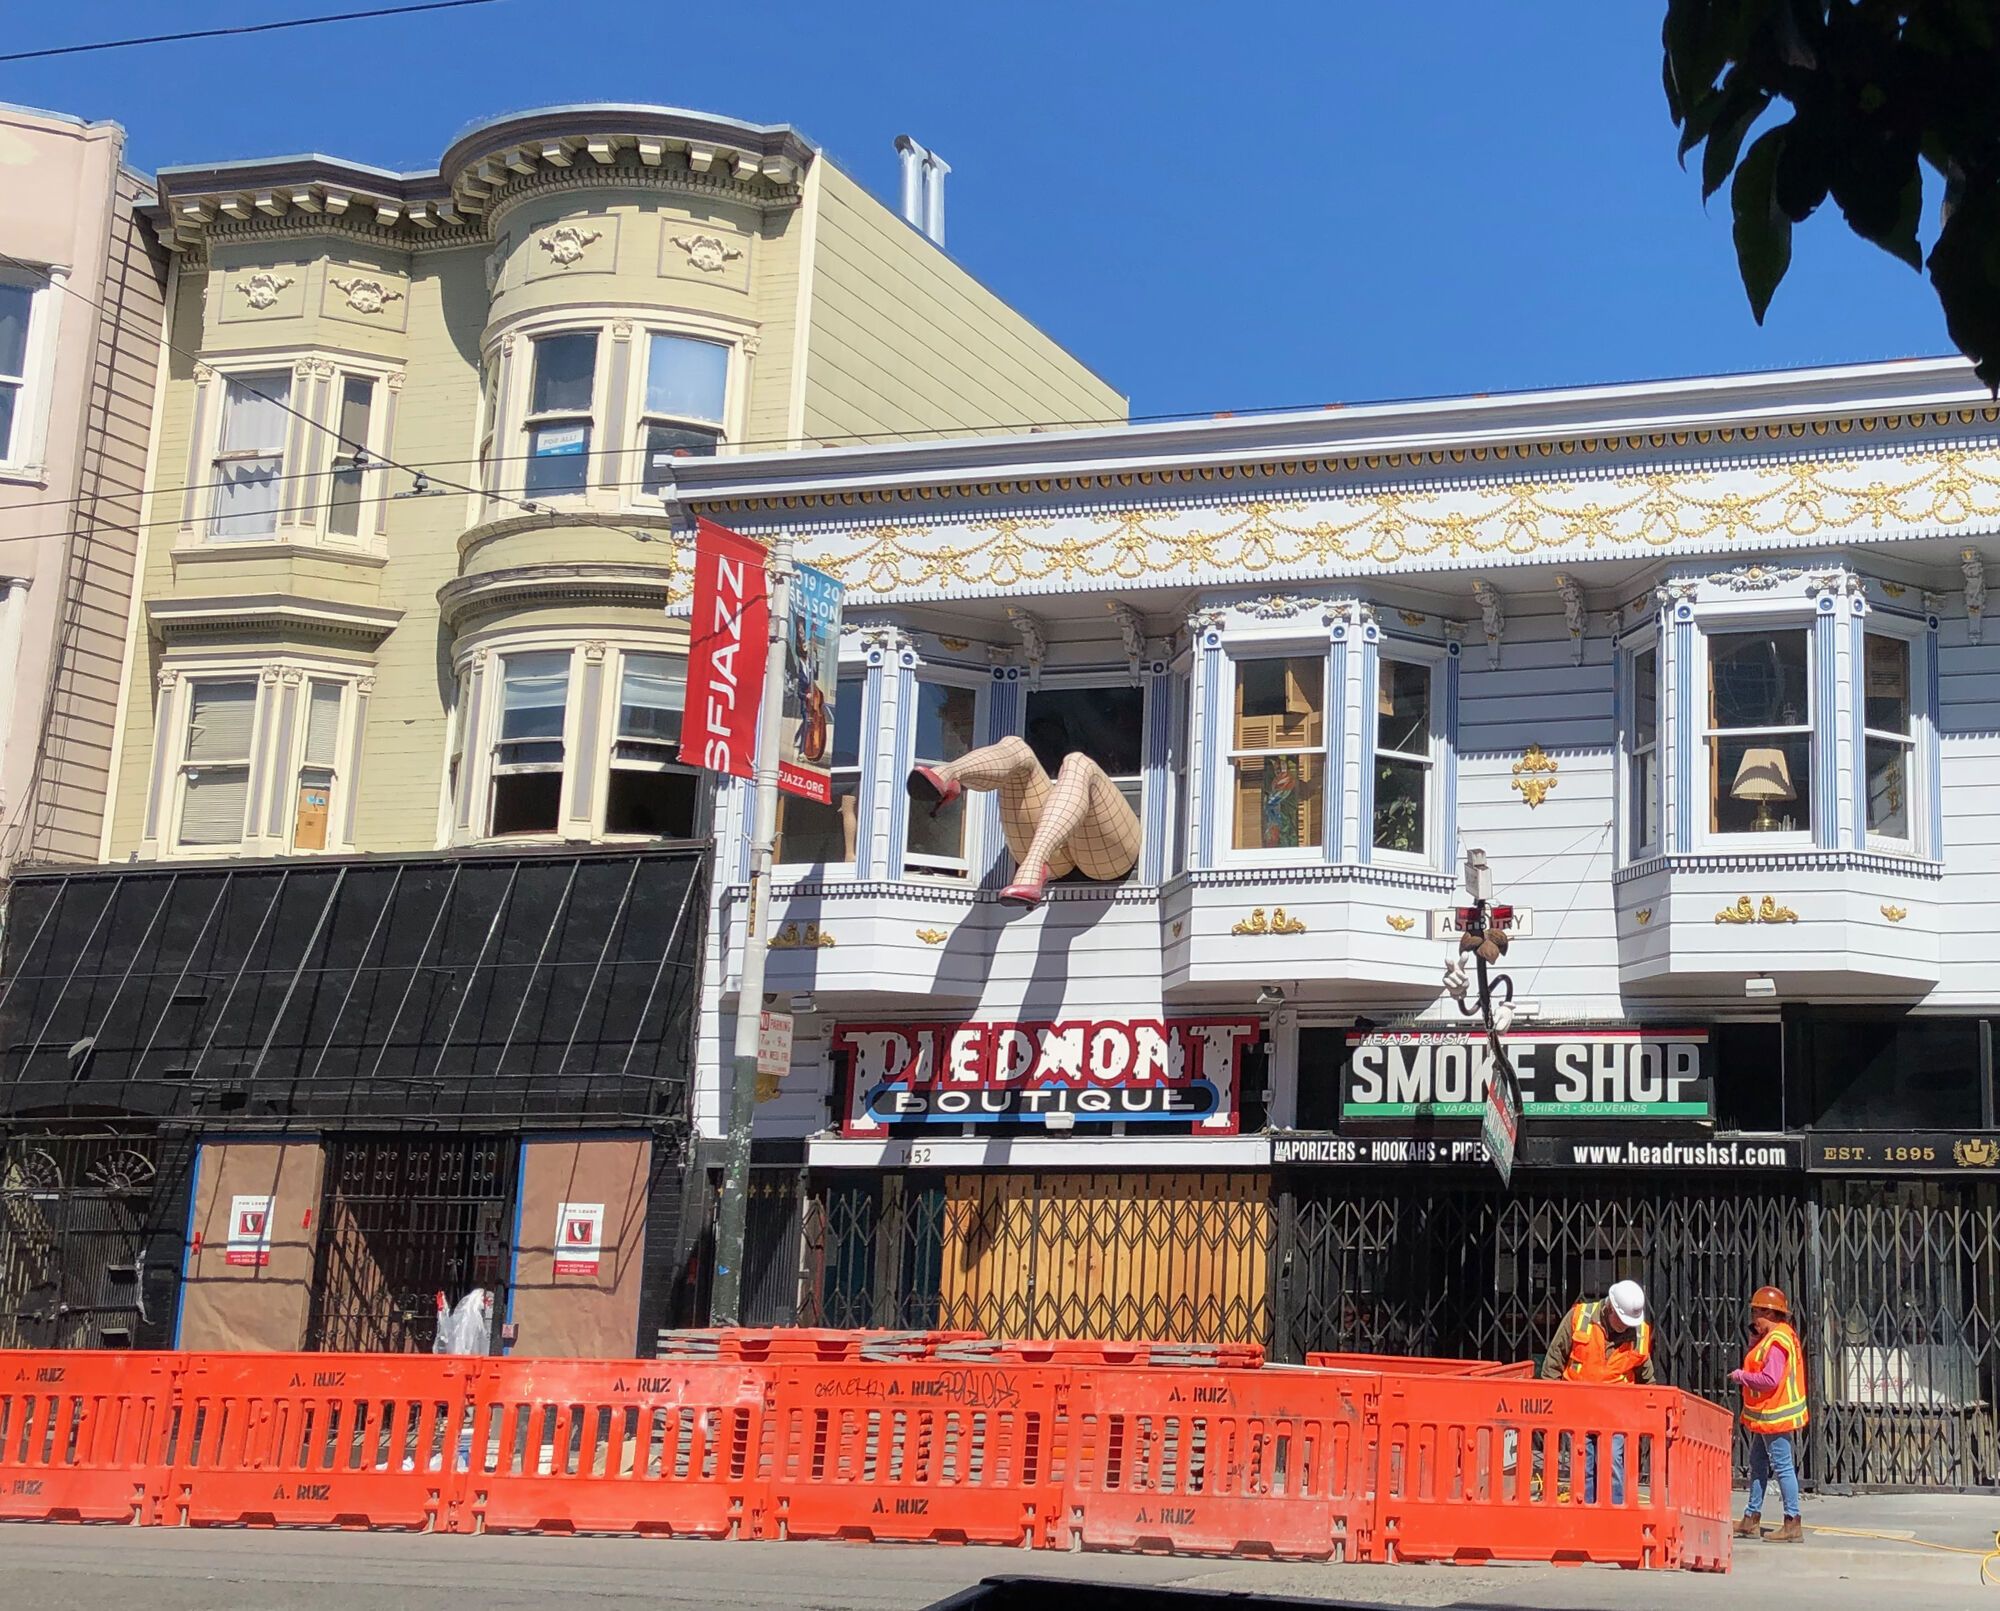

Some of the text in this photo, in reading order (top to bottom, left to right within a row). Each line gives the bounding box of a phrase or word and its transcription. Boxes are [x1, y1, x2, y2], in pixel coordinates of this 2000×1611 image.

[704, 554, 744, 773] SFJAZZ
[778, 770, 824, 794] FJAZZ.ORG
[1360, 1032, 1470, 1045] HEAD RUSH
[843, 1025, 1251, 1130] PIEDMONT
[1352, 1044, 1700, 1103] SMOKE SHOP
[896, 1090, 1195, 1113] BOUTIQUE
[1402, 1105, 1434, 1113] PIPES
[1580, 1104, 1647, 1113] SOUVENIRS
[901, 1148, 931, 1163] 1452
[1275, 1141, 1786, 1166] VAPORIZERS HOOKAHS PIPES www.headrushsf.com
[1823, 1147, 1936, 1160] EST. 1895
[16, 1368, 66, 1382] A. RUIZ
[289, 1372, 346, 1387] A. RUIZ
[612, 1377, 671, 1393] A. RUIZ
[888, 1381, 944, 1396] A. RUIZ
[1169, 1387, 1228, 1403] A. RUIZ
[1496, 1398, 1553, 1414] A. RUIZ
[273, 1484, 331, 1500] A. RUIZ
[872, 1497, 928, 1514] A. RUIZ
[1136, 1508, 1196, 1525] A. RUIZ
